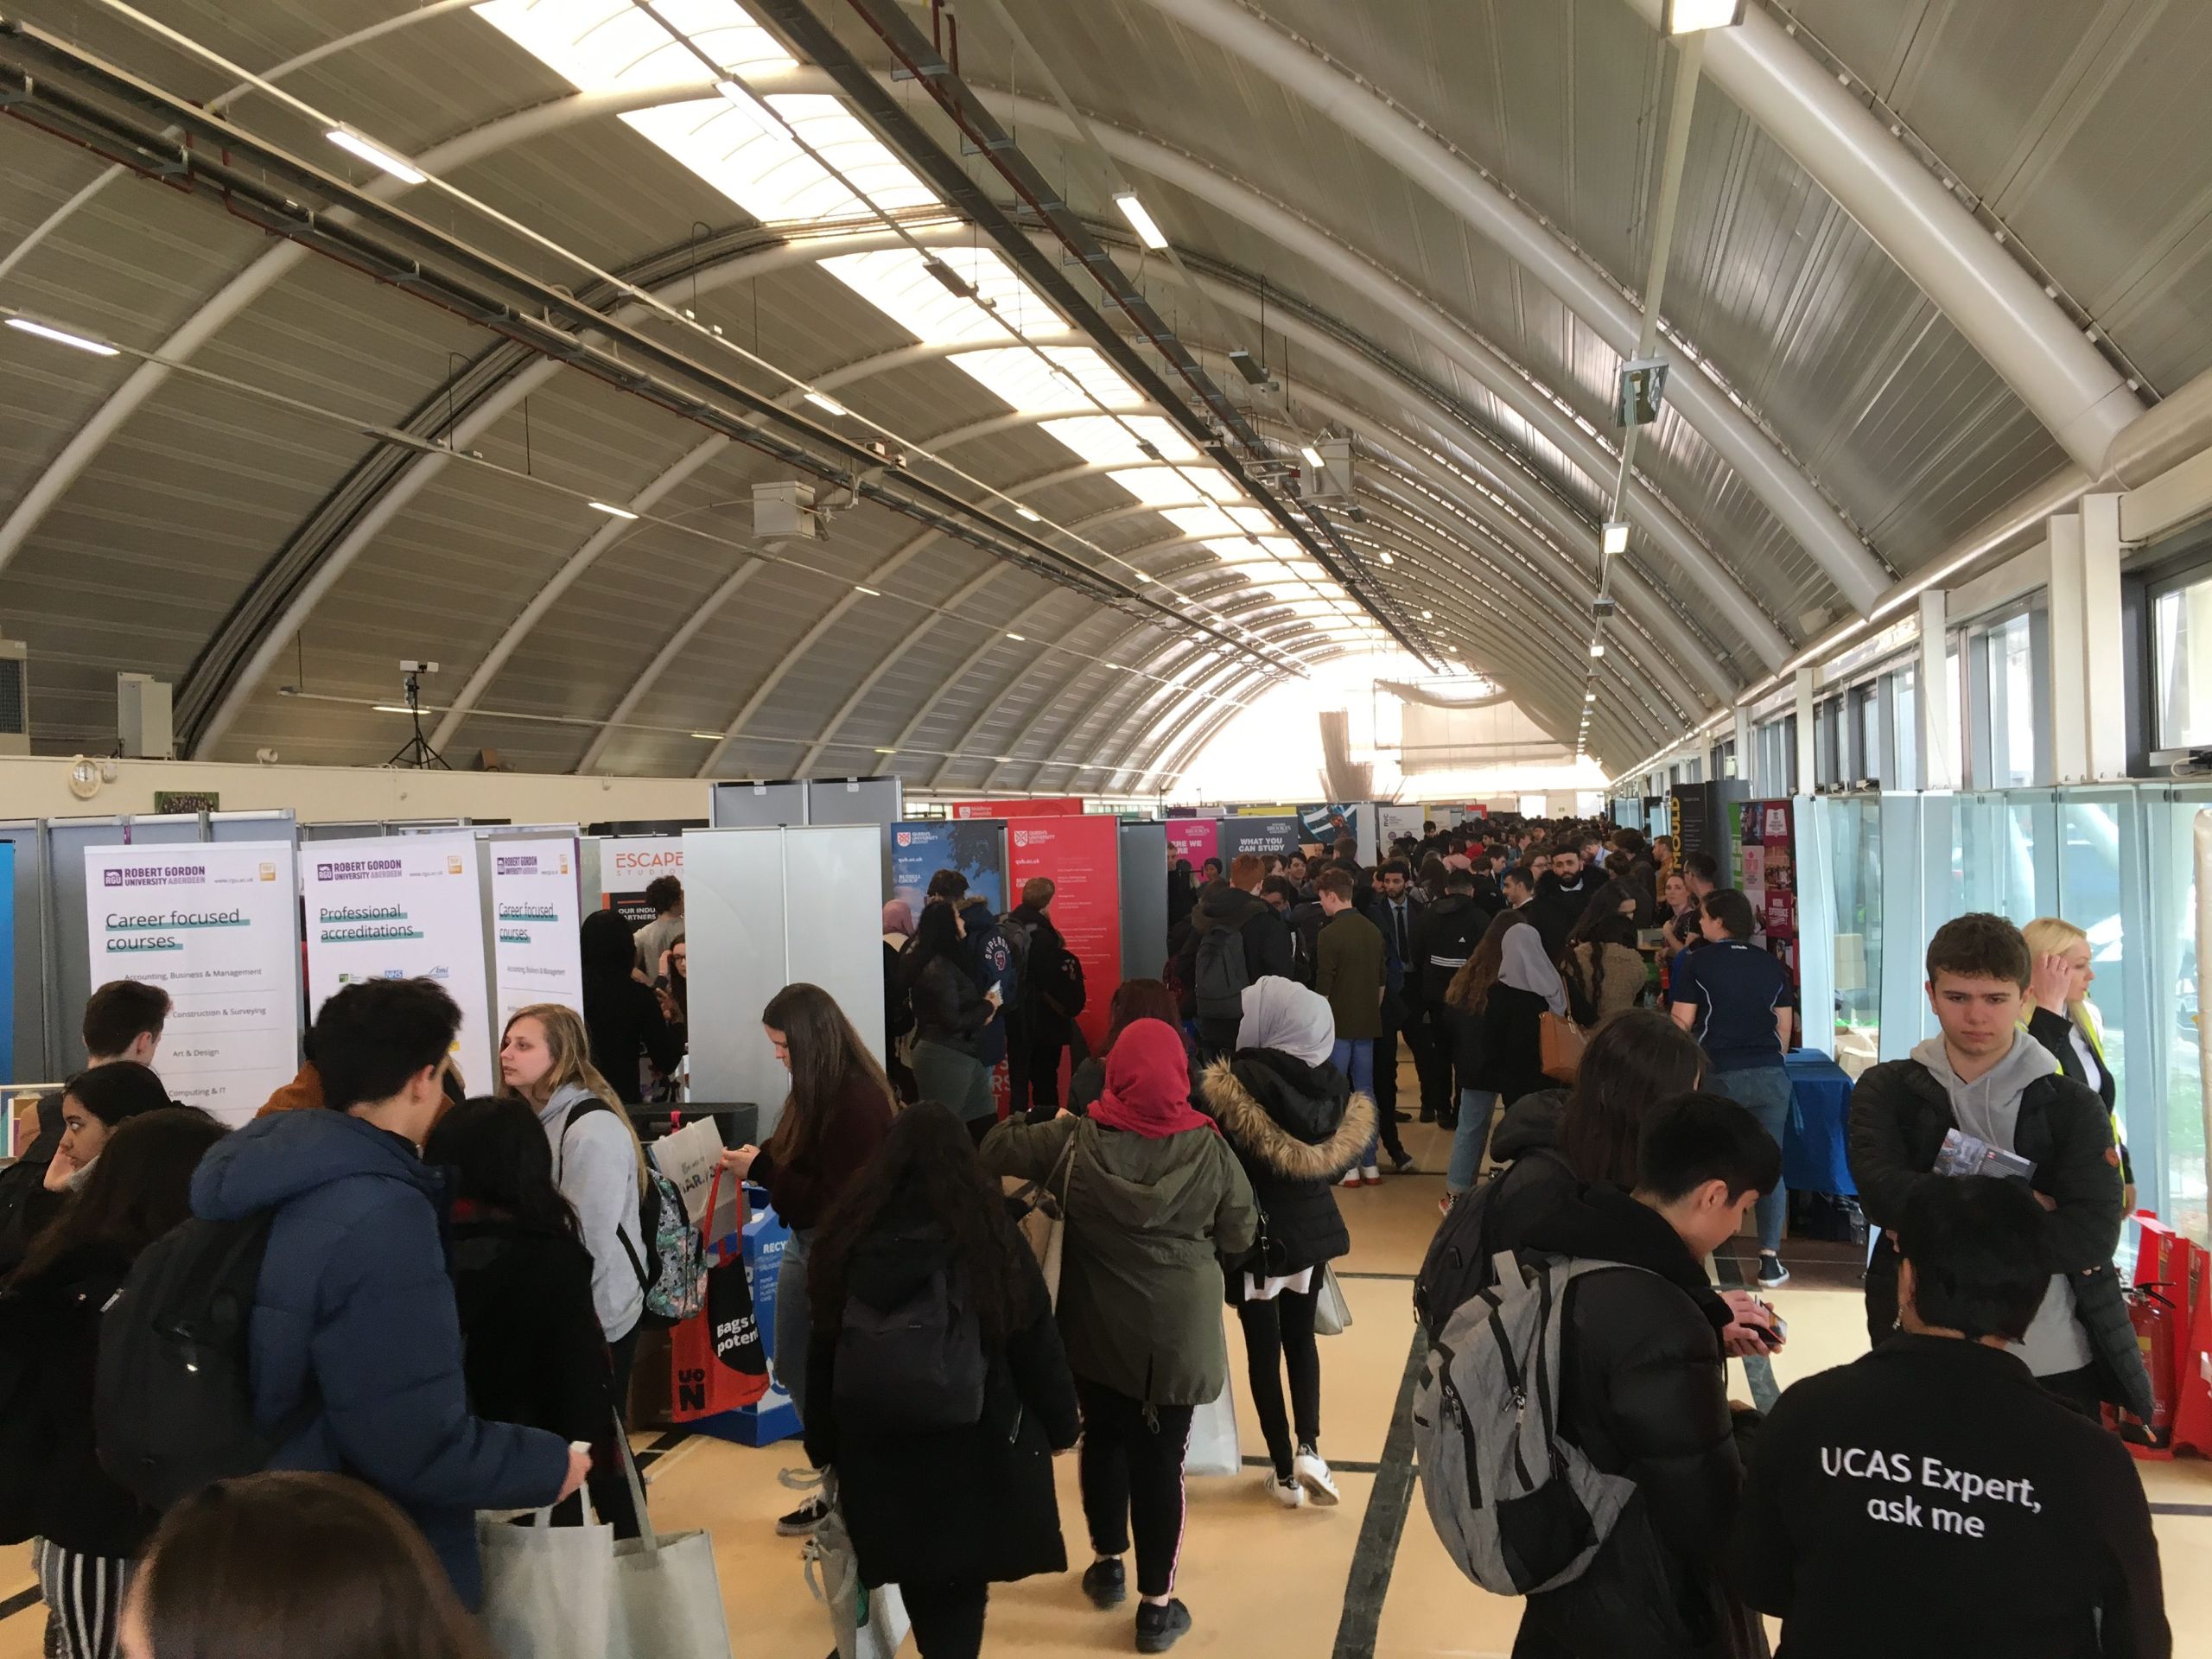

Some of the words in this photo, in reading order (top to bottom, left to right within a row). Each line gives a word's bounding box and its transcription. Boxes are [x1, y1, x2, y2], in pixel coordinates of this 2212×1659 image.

[1671, 797, 1681, 869] MOULD
[334, 861, 366, 873] ROBERT
[368, 860, 402, 871] GORDON
[616, 851, 683, 868] ESCAPE
[124, 868, 162, 878] ROBERT
[165, 865, 206, 877] GORDON
[334, 871, 370, 880] UNIVERSITY
[371, 870, 402, 879] ABERDEEN
[105, 875, 122, 885] RGU
[124, 877, 168, 887] UNIVERSITY
[168, 875, 206, 886] ABERDEEN
[320, 903, 402, 921] Professional
[499, 903, 522, 918] Career
[524, 902, 554, 918] focused
[623, 913, 657, 922] ARTNERS
[105, 912, 165, 929] Career
[171, 908, 240, 926] focused
[321, 924, 414, 941] accreditations
[499, 927, 529, 941] courses
[106, 935, 176, 951] courses
[124, 973, 168, 982] Accounting,
[170, 970, 204, 979] Business
[213, 968, 263, 978] Management
[173, 1009, 221, 1018] Construction
[230, 1007, 267, 1016] Surveying
[194, 1048, 220, 1058] Design
[168, 1089, 210, 1098] Computing
[763, 1240, 788, 1255] RECY
[716, 1316, 749, 1338] Bags
[717, 1326, 759, 1357] poten
[1821, 1446, 1912, 1484] UCAS
[1921, 1456, 2043, 1515] Expert,
[1866, 1494, 1923, 1529] ask
[1931, 1507, 1986, 1538] me
